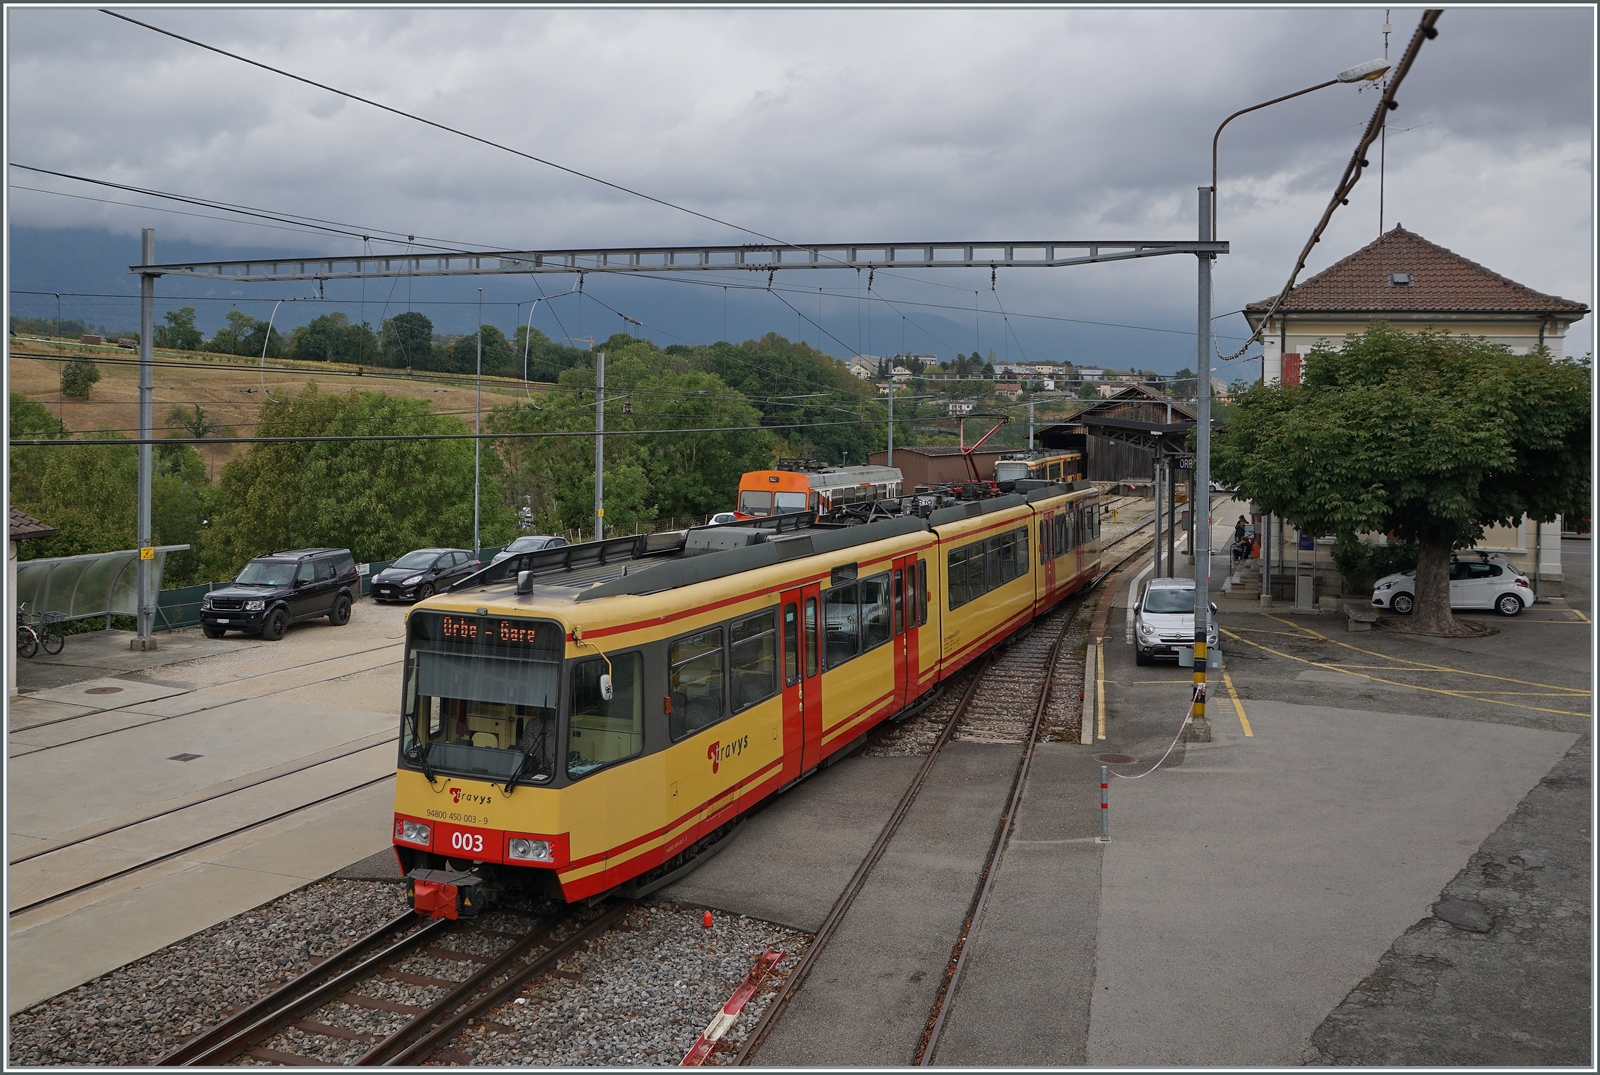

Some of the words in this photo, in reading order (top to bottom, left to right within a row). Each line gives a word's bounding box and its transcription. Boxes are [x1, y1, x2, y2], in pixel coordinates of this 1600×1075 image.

[443, 616, 477, 638] Orbe
[500, 620, 535, 642] Gare
[712, 734, 748, 768] travys
[451, 787, 492, 804] travys
[426, 808, 447, 819] 94800
[449, 812, 461, 821] 450
[463, 814, 476, 823] 003
[483, 816, 488, 825] 9
[451, 831, 483, 852] 003
